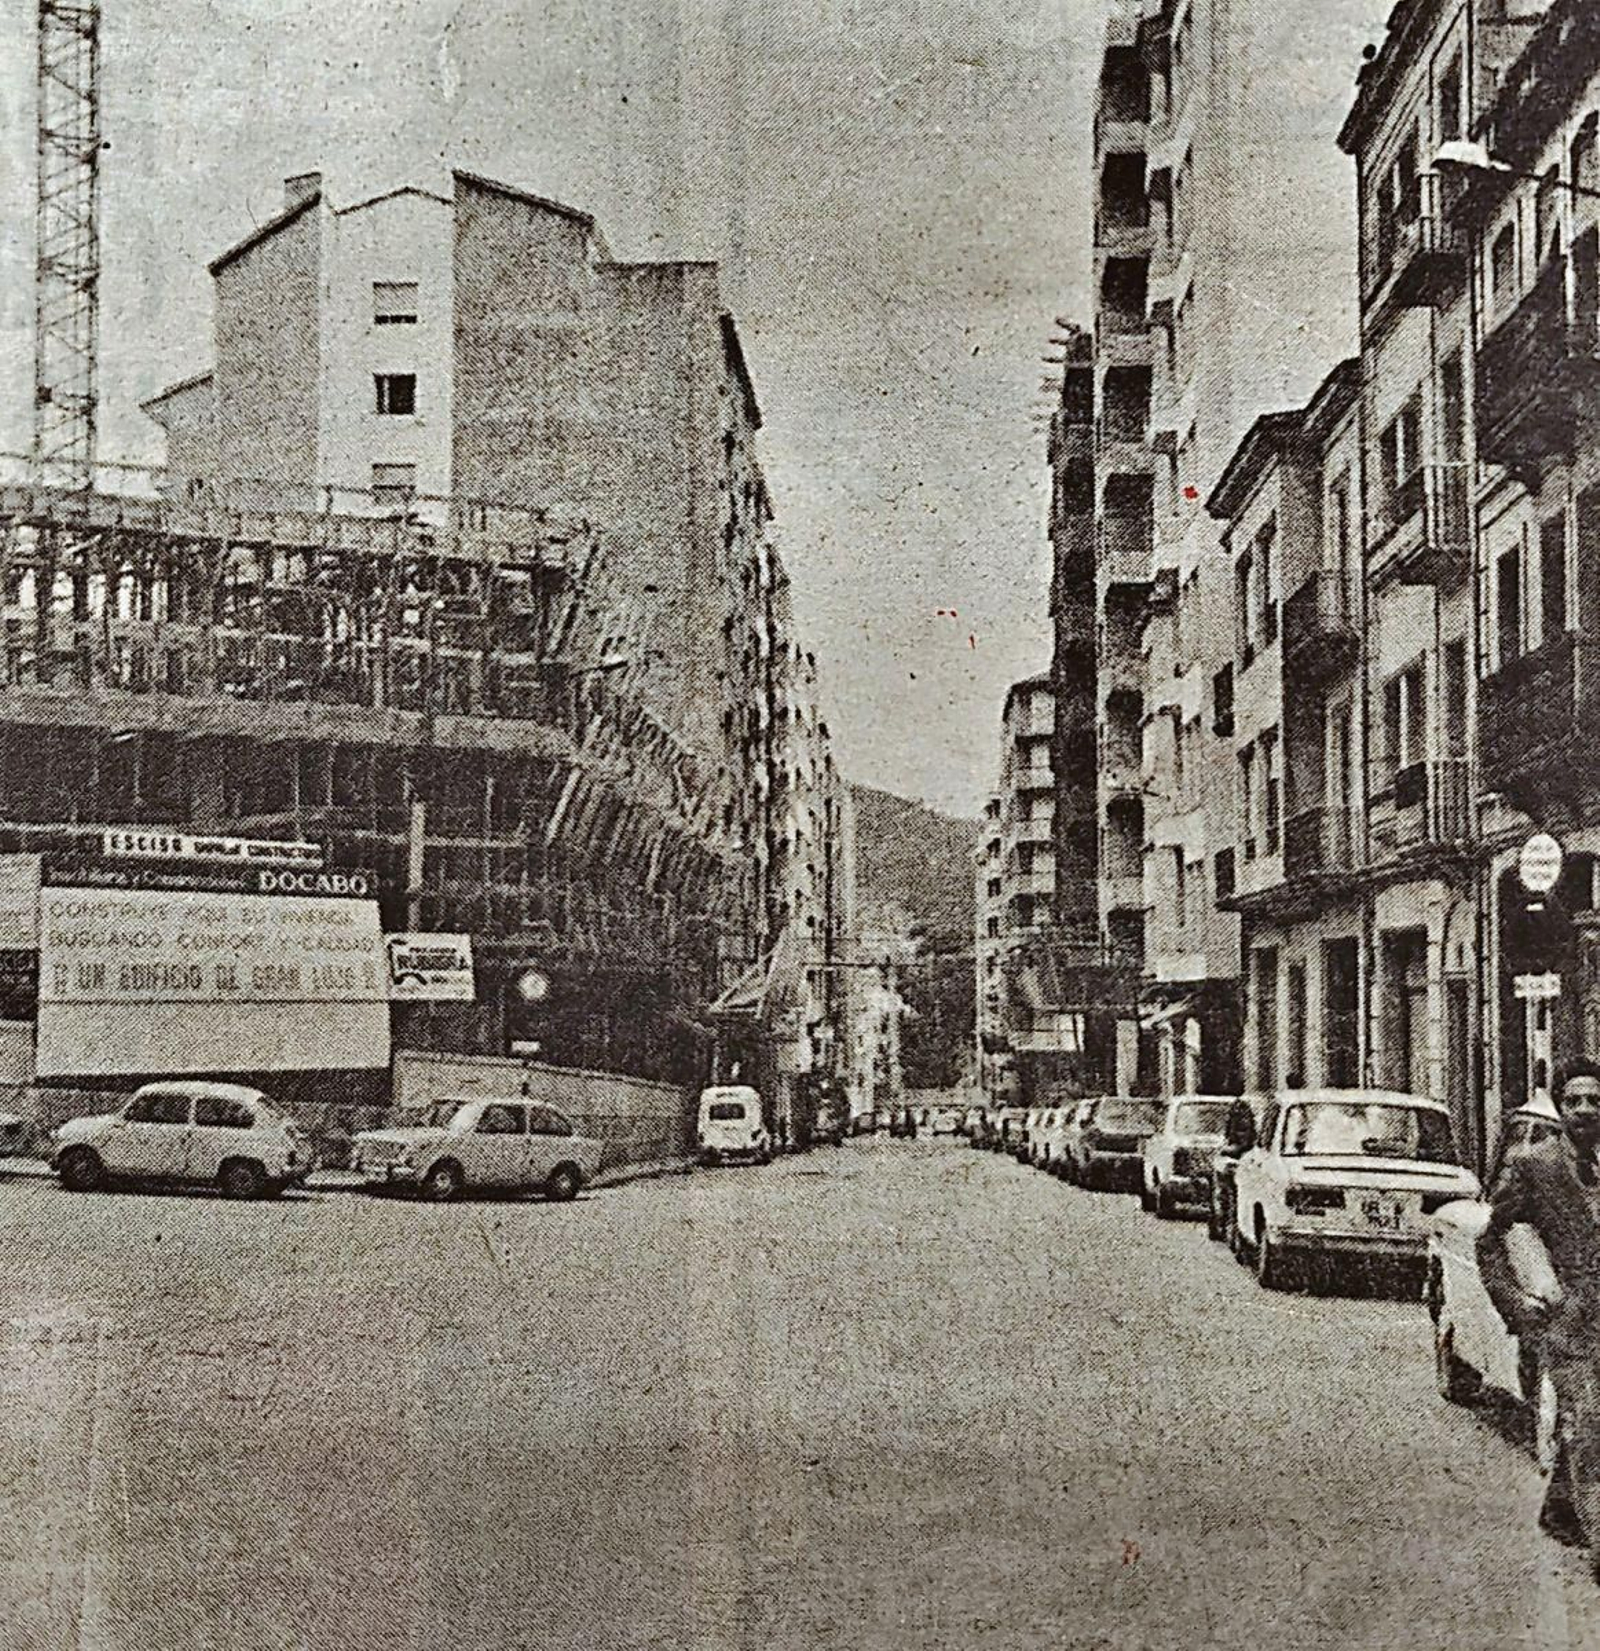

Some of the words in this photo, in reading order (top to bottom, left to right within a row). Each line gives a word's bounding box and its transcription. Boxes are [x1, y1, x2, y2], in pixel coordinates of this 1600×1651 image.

[259, 869, 368, 896] DOCABO
[49, 929, 164, 949] BUSCANDO
[118, 962, 204, 992] EDIFICIO
